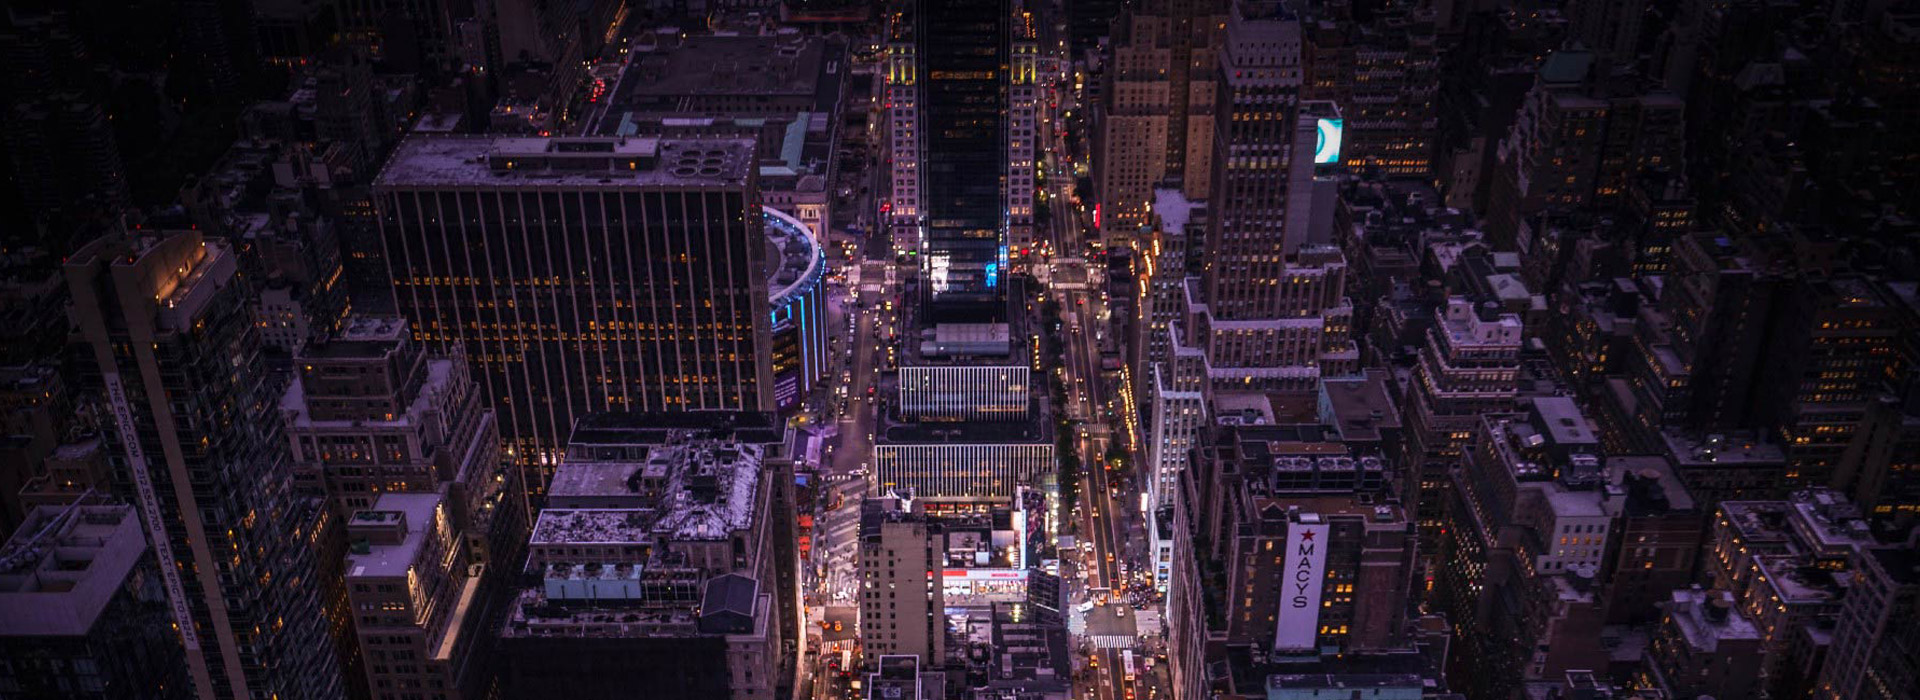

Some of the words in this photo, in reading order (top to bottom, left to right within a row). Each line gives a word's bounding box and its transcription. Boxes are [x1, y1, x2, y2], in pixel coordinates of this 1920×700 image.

[110, 380, 123, 403] THE
[158, 542, 172, 567] TEXT
[175, 599, 185, 612] TO
[1293, 543, 1314, 608] MACYS
